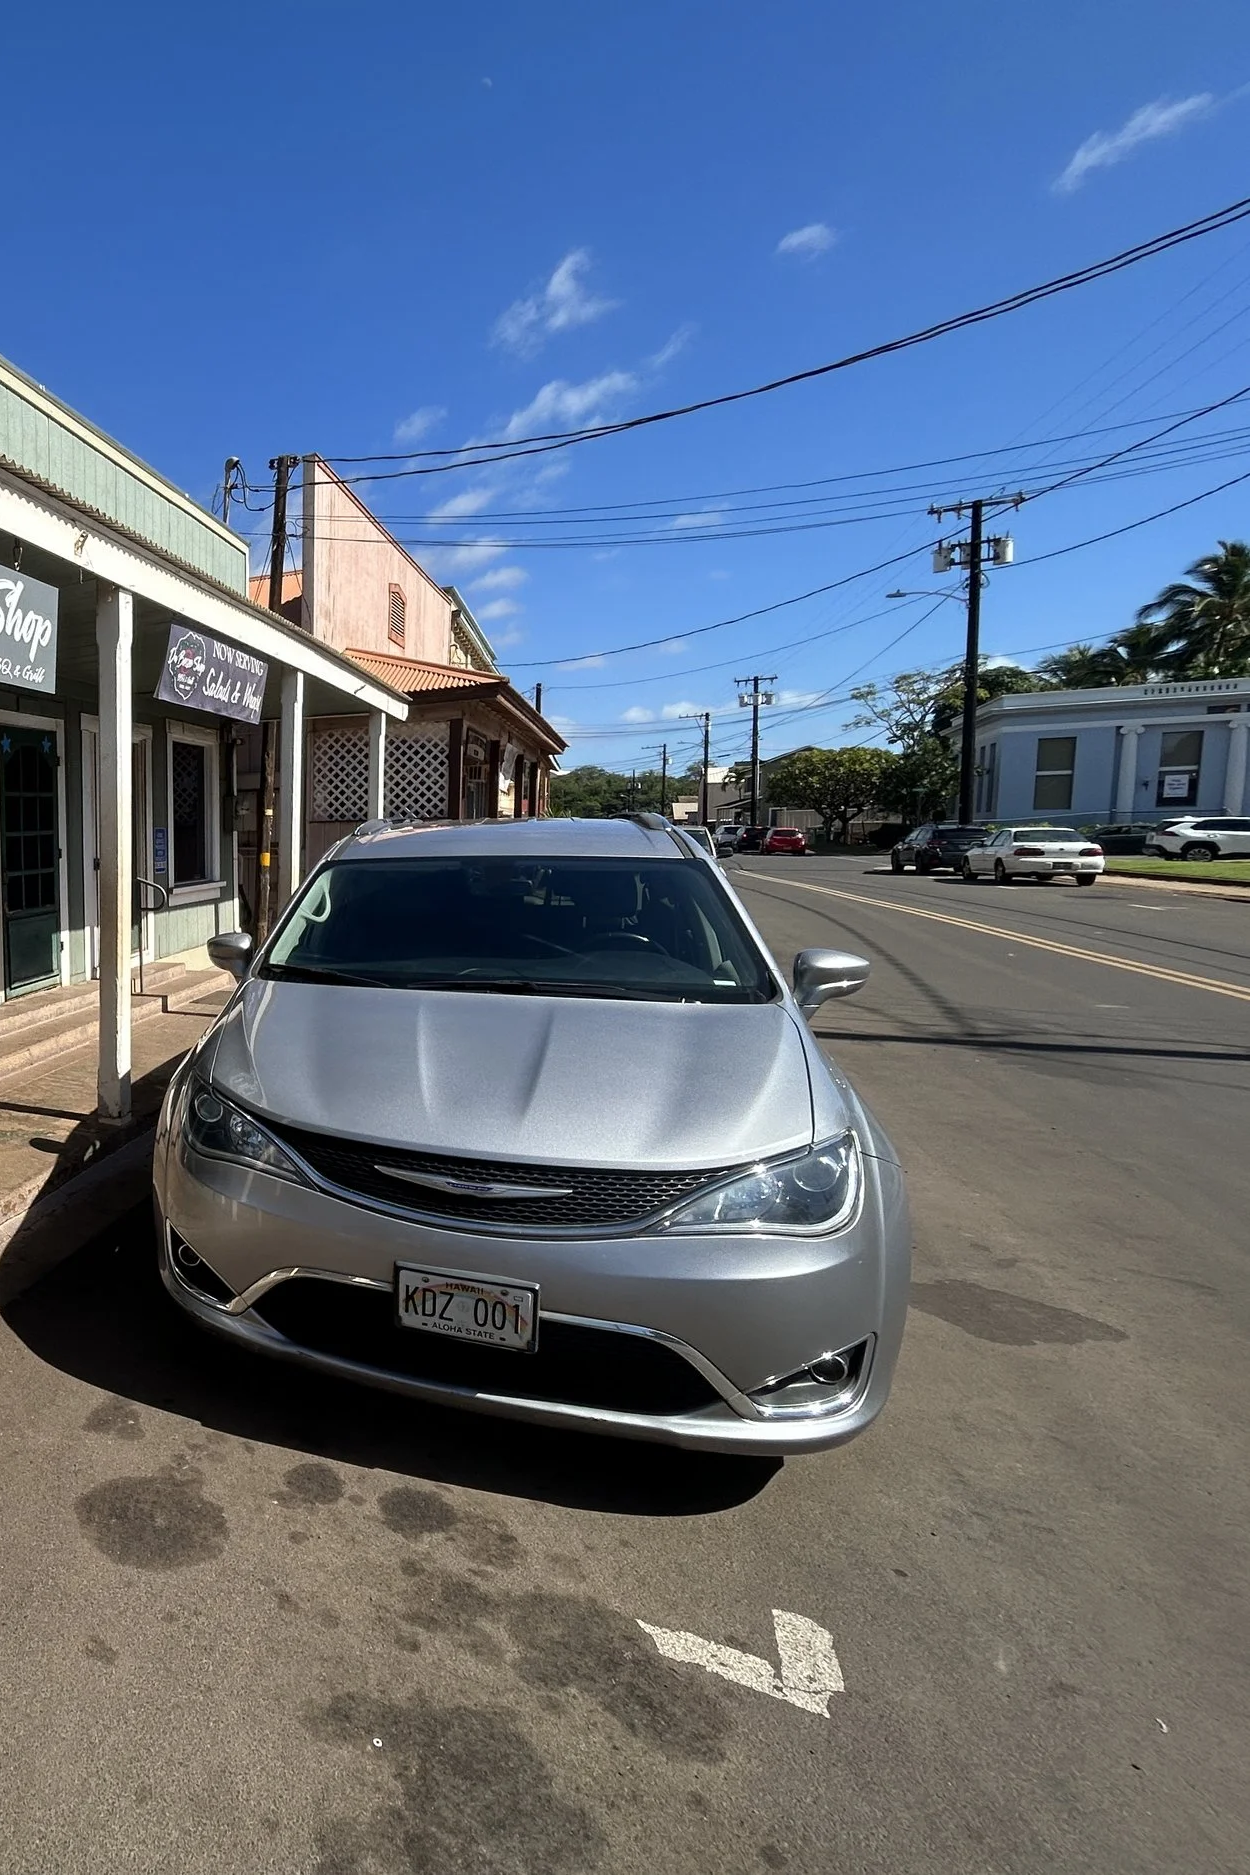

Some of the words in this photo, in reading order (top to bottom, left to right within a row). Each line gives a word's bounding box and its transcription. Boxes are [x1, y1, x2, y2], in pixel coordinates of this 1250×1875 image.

[213, 641, 235, 664] NOW
[235, 651, 264, 676] SERVING
[13, 665, 21, 678] &
[22, 665, 46, 684] Grill
[203, 668, 231, 703] Salads
[230, 681, 241, 704] &
[445, 1281, 484, 1295] HAWAII
[404, 1284, 455, 1322] KDZ
[474, 1297, 521, 1334] 001
[431, 1322, 463, 1334] ALOHA
[465, 1328, 496, 1340] STATE
